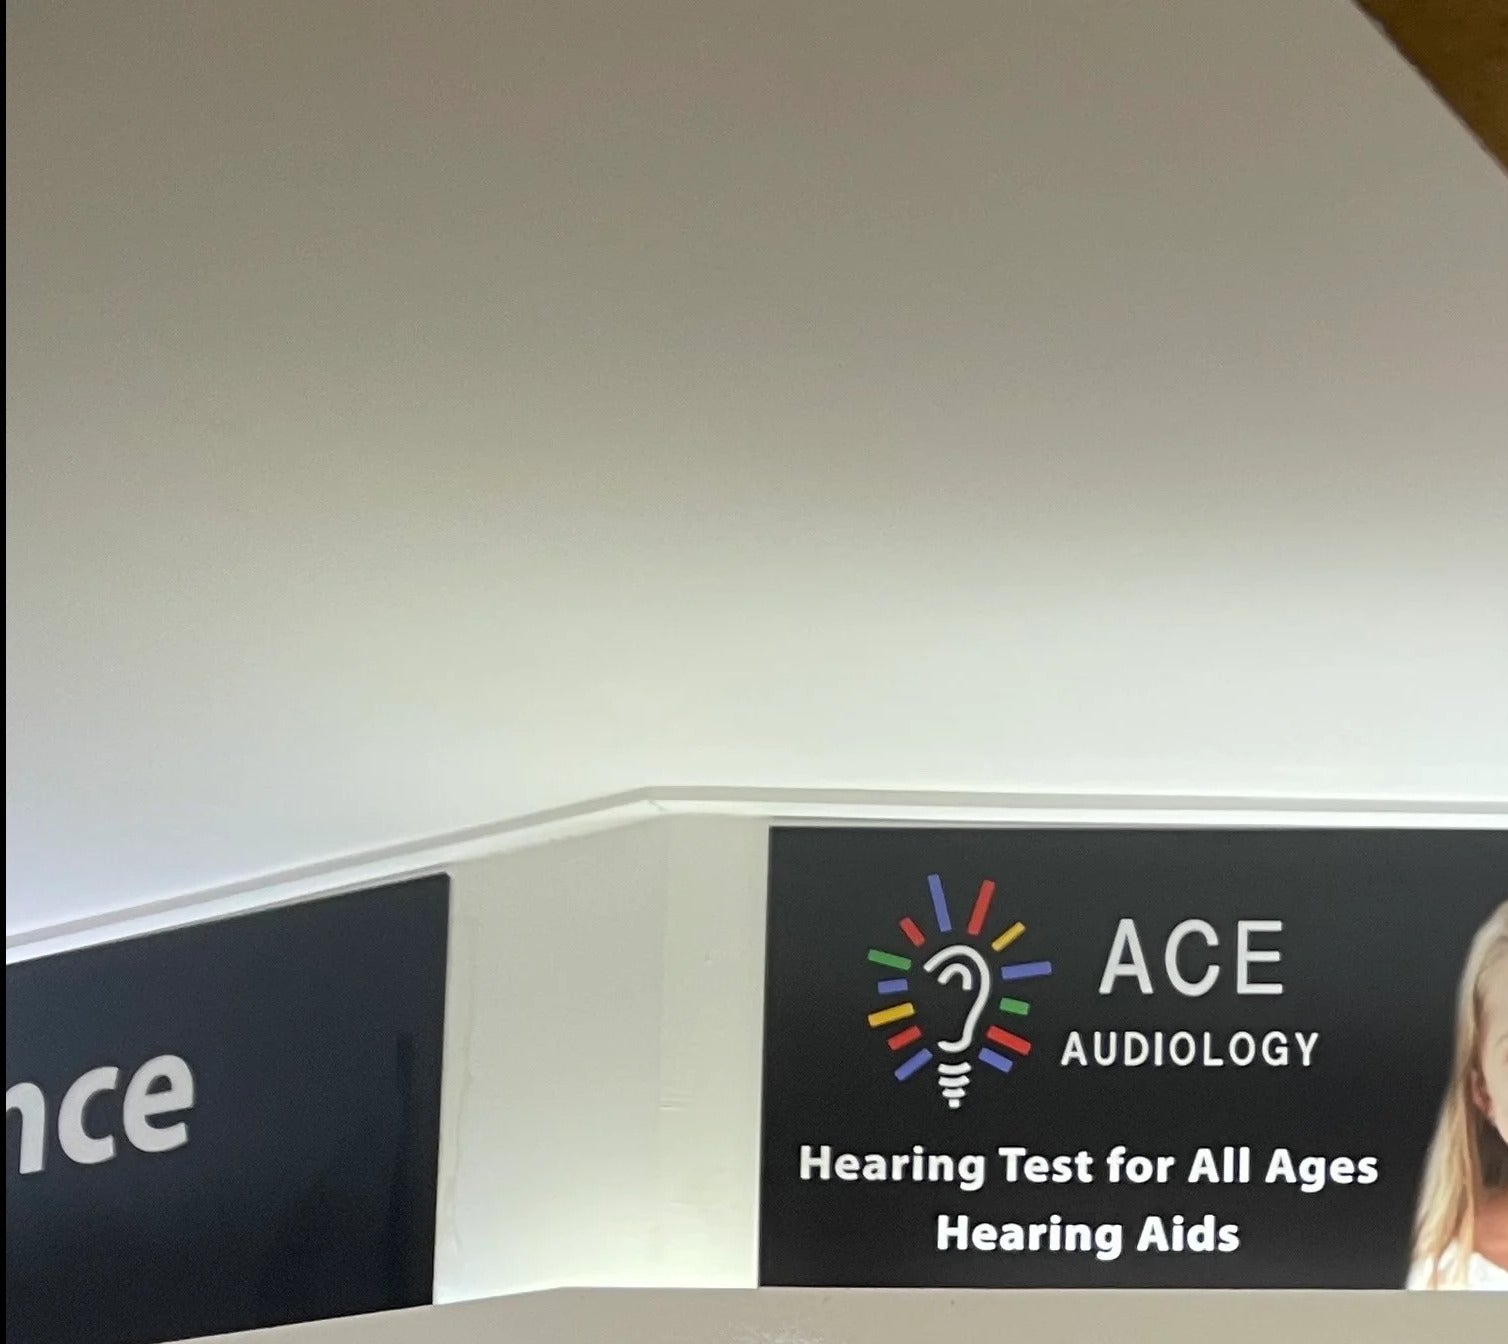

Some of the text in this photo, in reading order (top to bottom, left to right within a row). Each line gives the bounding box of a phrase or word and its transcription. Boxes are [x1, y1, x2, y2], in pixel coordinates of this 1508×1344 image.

[1099, 919, 1282, 996] ACE
[1061, 1031, 1318, 1066] AUDIOLOGY
[801, 1146, 1378, 1192] Hearing Test for All Ages
[938, 1215, 1239, 1260] Hearing Aids
